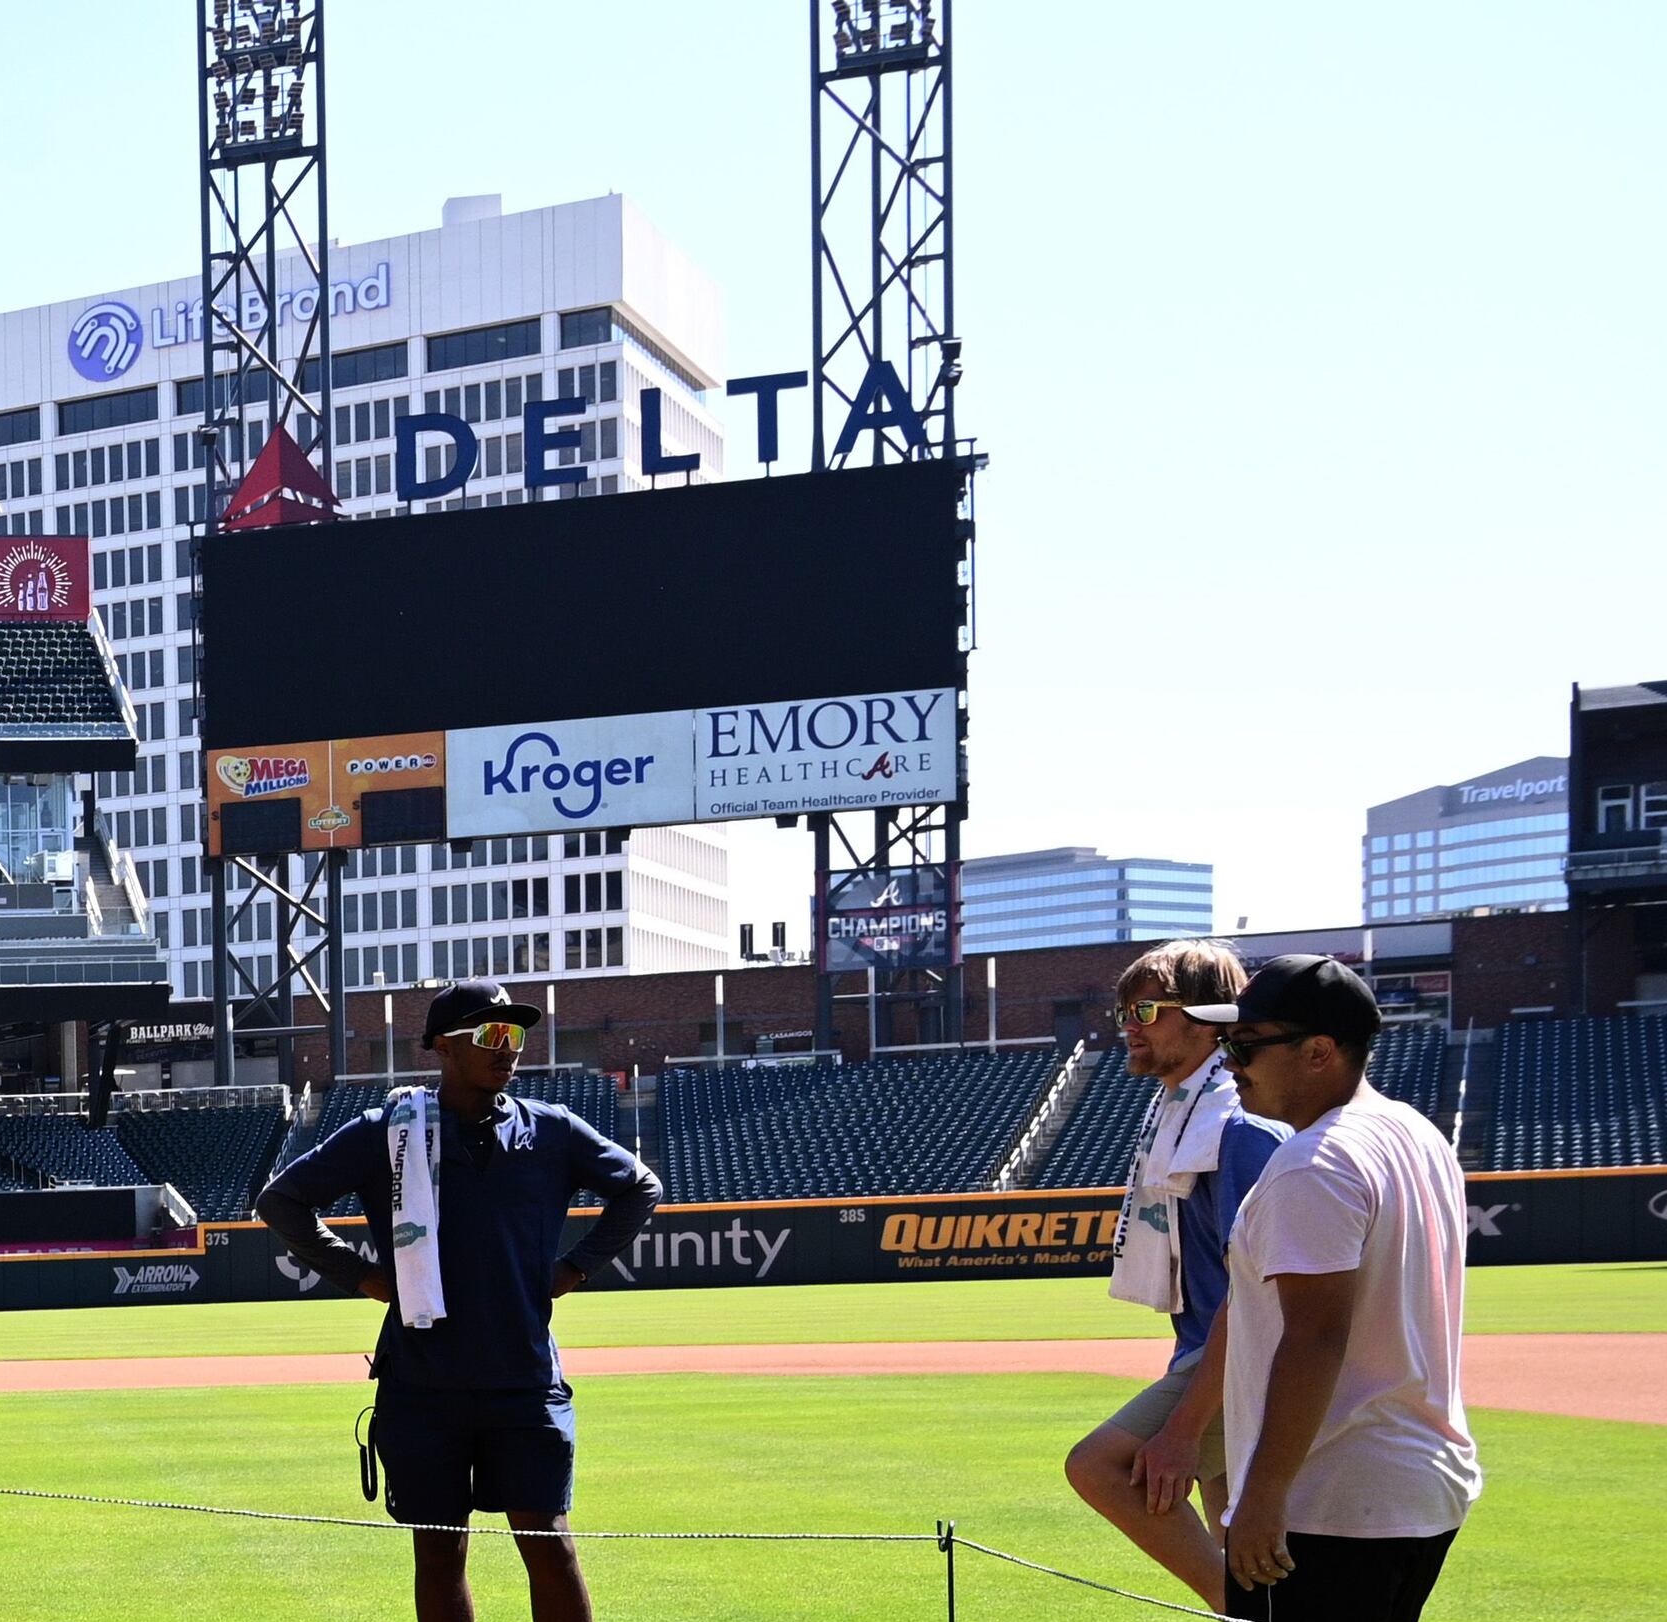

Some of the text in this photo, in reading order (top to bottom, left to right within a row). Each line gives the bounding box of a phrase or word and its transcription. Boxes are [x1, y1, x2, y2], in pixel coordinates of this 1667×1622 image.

[150, 262, 391, 349] LifeBrand
[395, 360, 928, 501] DELTA
[707, 693, 944, 758] EMORY
[248, 758, 308, 782] MEGA
[484, 732, 655, 819] Kroger
[709, 751, 933, 787] HEALTHCARE
[243, 775, 309, 796] MILLIONS
[1458, 774, 1567, 804] Travelport
[710, 787, 940, 814] Official Team Healthcare Provider
[310, 817, 349, 827] LOTTERY
[827, 910, 947, 939] CHAMPIONS
[130, 1022, 215, 1039] BALLPARK Clas
[839, 1209, 866, 1224] 385
[205, 1233, 229, 1246] 375
[880, 1210, 1122, 1253] QUIKRETE
[898, 1256, 941, 1268] What
[946, 1253, 1028, 1266] America's
[1034, 1252, 1084, 1264] Made
[133, 1265, 188, 1283] ARROW
[131, 1282, 187, 1294] EXTERMINATORS
